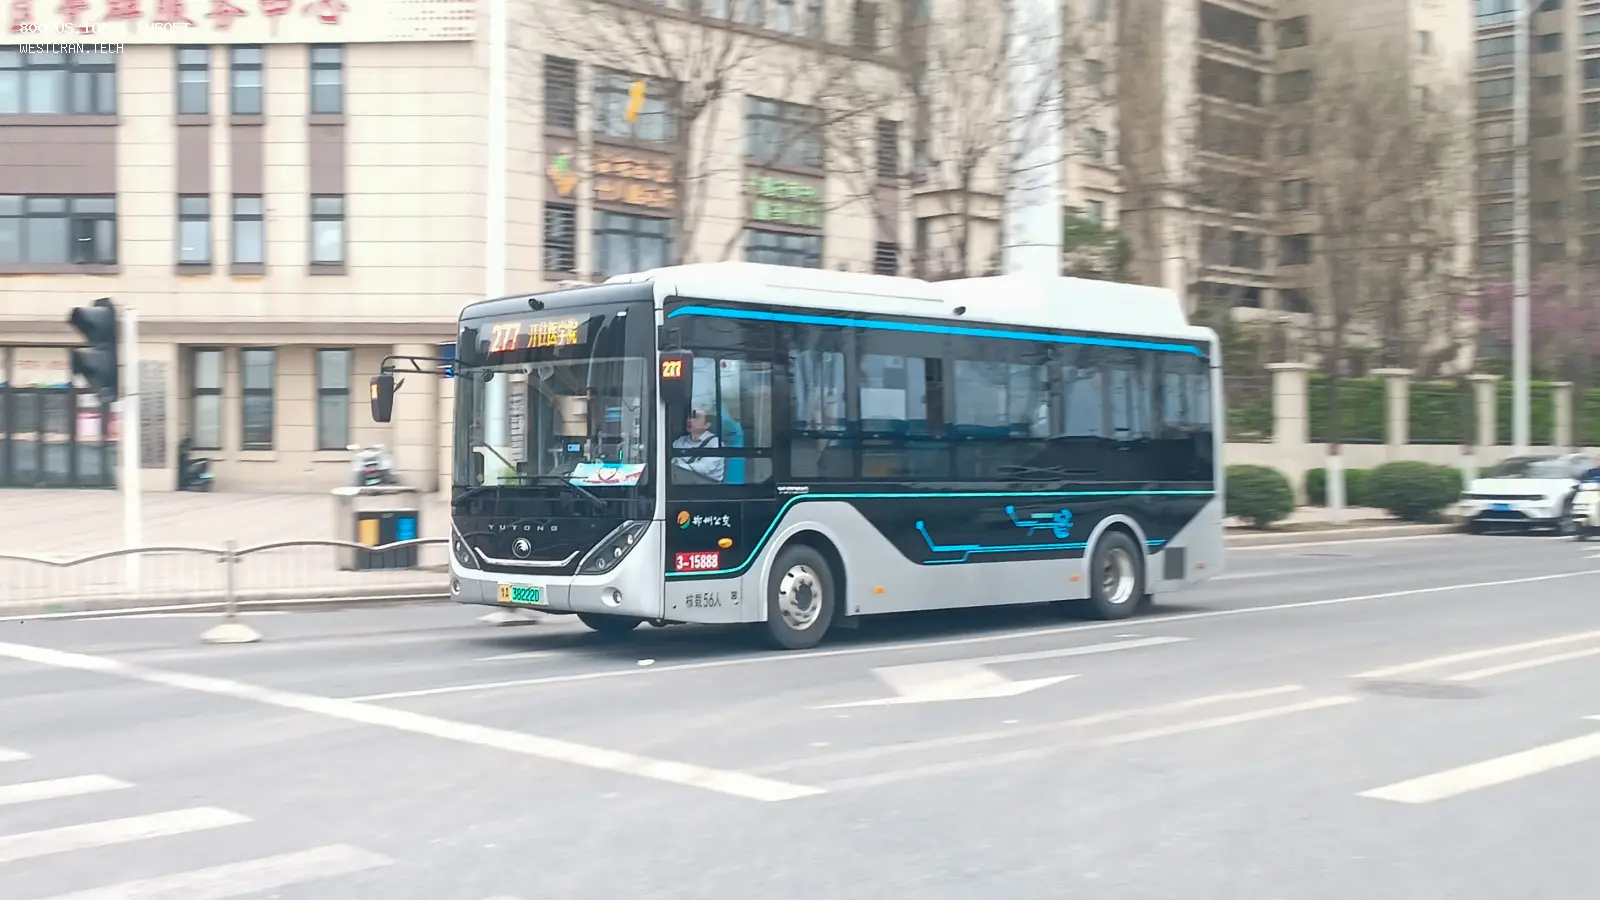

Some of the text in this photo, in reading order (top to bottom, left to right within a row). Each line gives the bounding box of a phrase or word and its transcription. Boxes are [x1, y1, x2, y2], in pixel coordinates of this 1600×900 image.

[490, 322, 522, 352] 277
[661, 359, 684, 378] 277
[488, 524, 558, 532] YUTONG
[692, 514, 731, 528] 郑州公交
[676, 553, 719, 570] 3-15888
[686, 592, 722, 609] 核载56人
